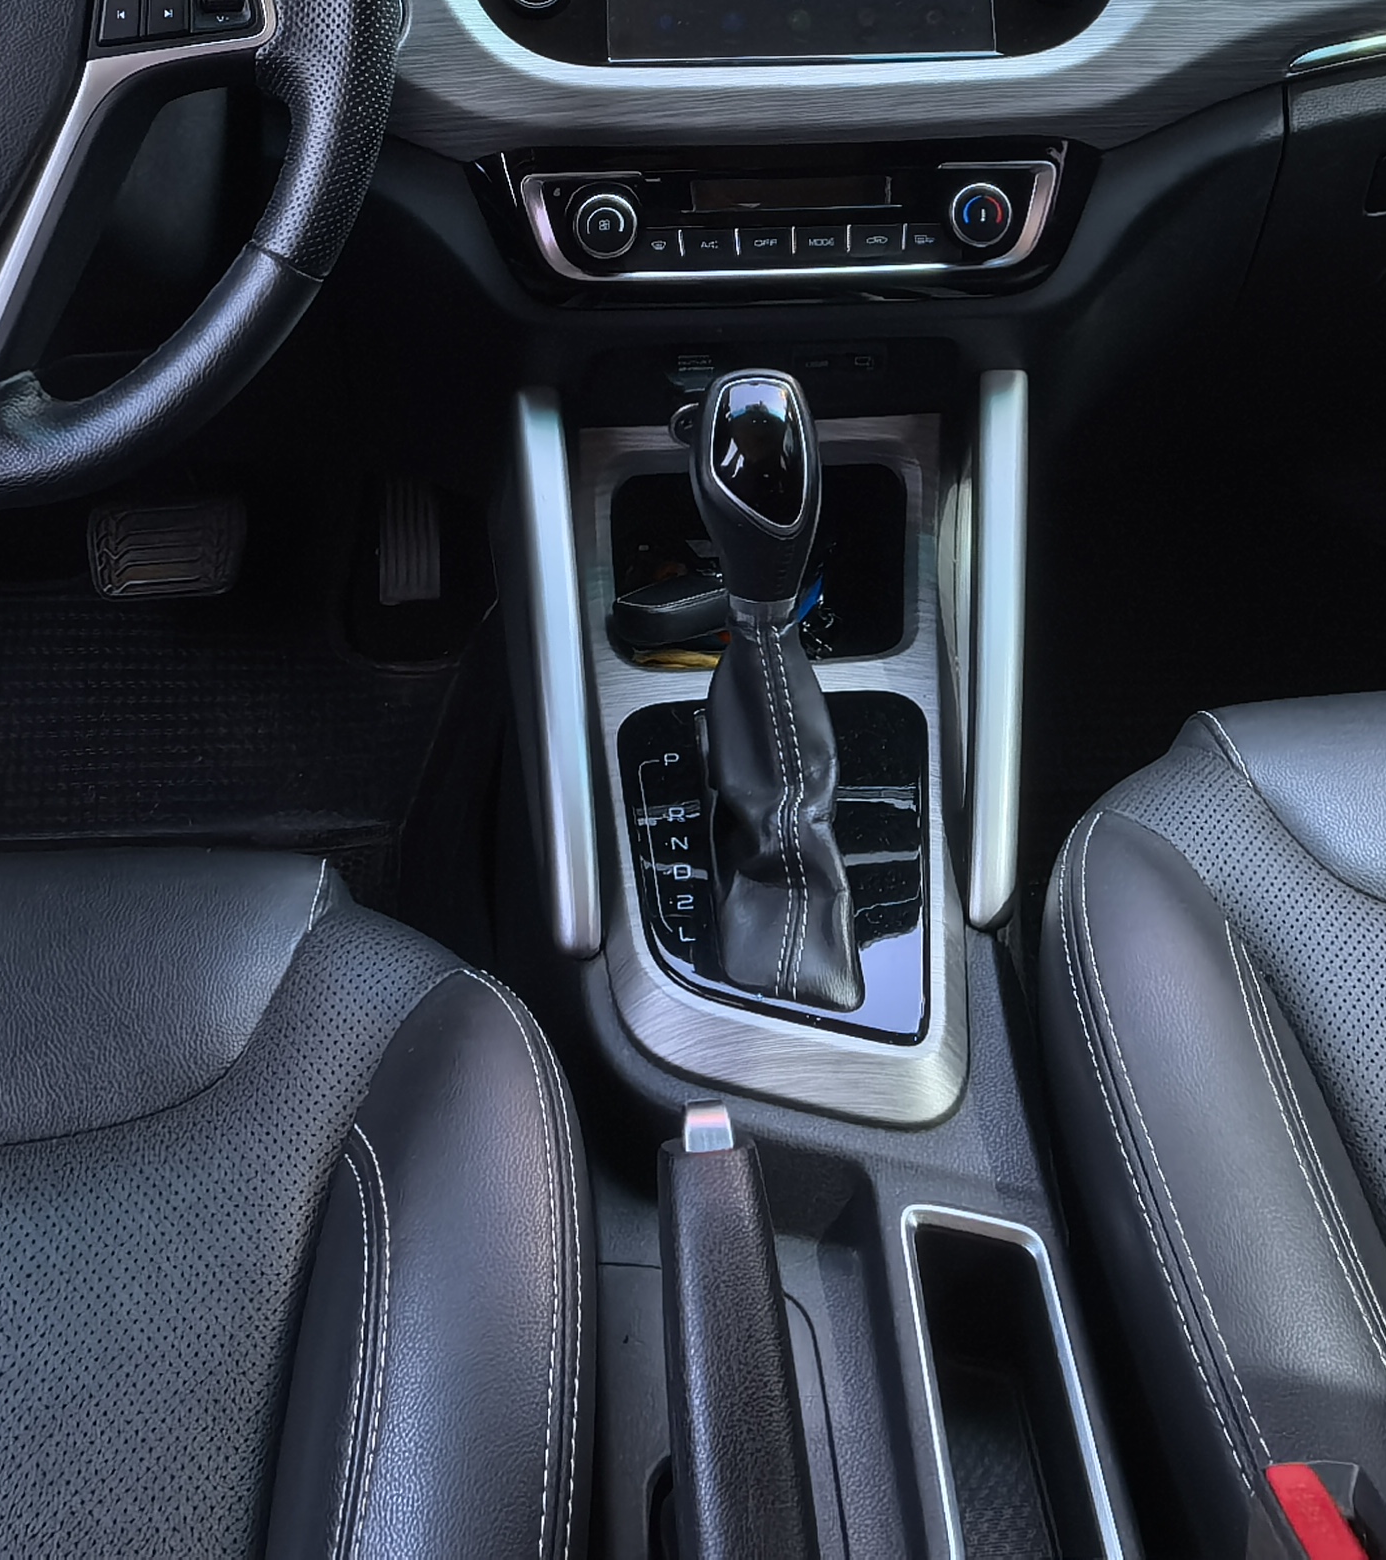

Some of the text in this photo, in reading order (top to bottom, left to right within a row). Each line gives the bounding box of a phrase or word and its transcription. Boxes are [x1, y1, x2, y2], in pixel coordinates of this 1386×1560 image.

[664, 753, 679, 766] P
[669, 806, 685, 822] R
[671, 836, 689, 850] N
[673, 864, 692, 880] D
[676, 894, 694, 910] 2
[679, 926, 696, 942] L
